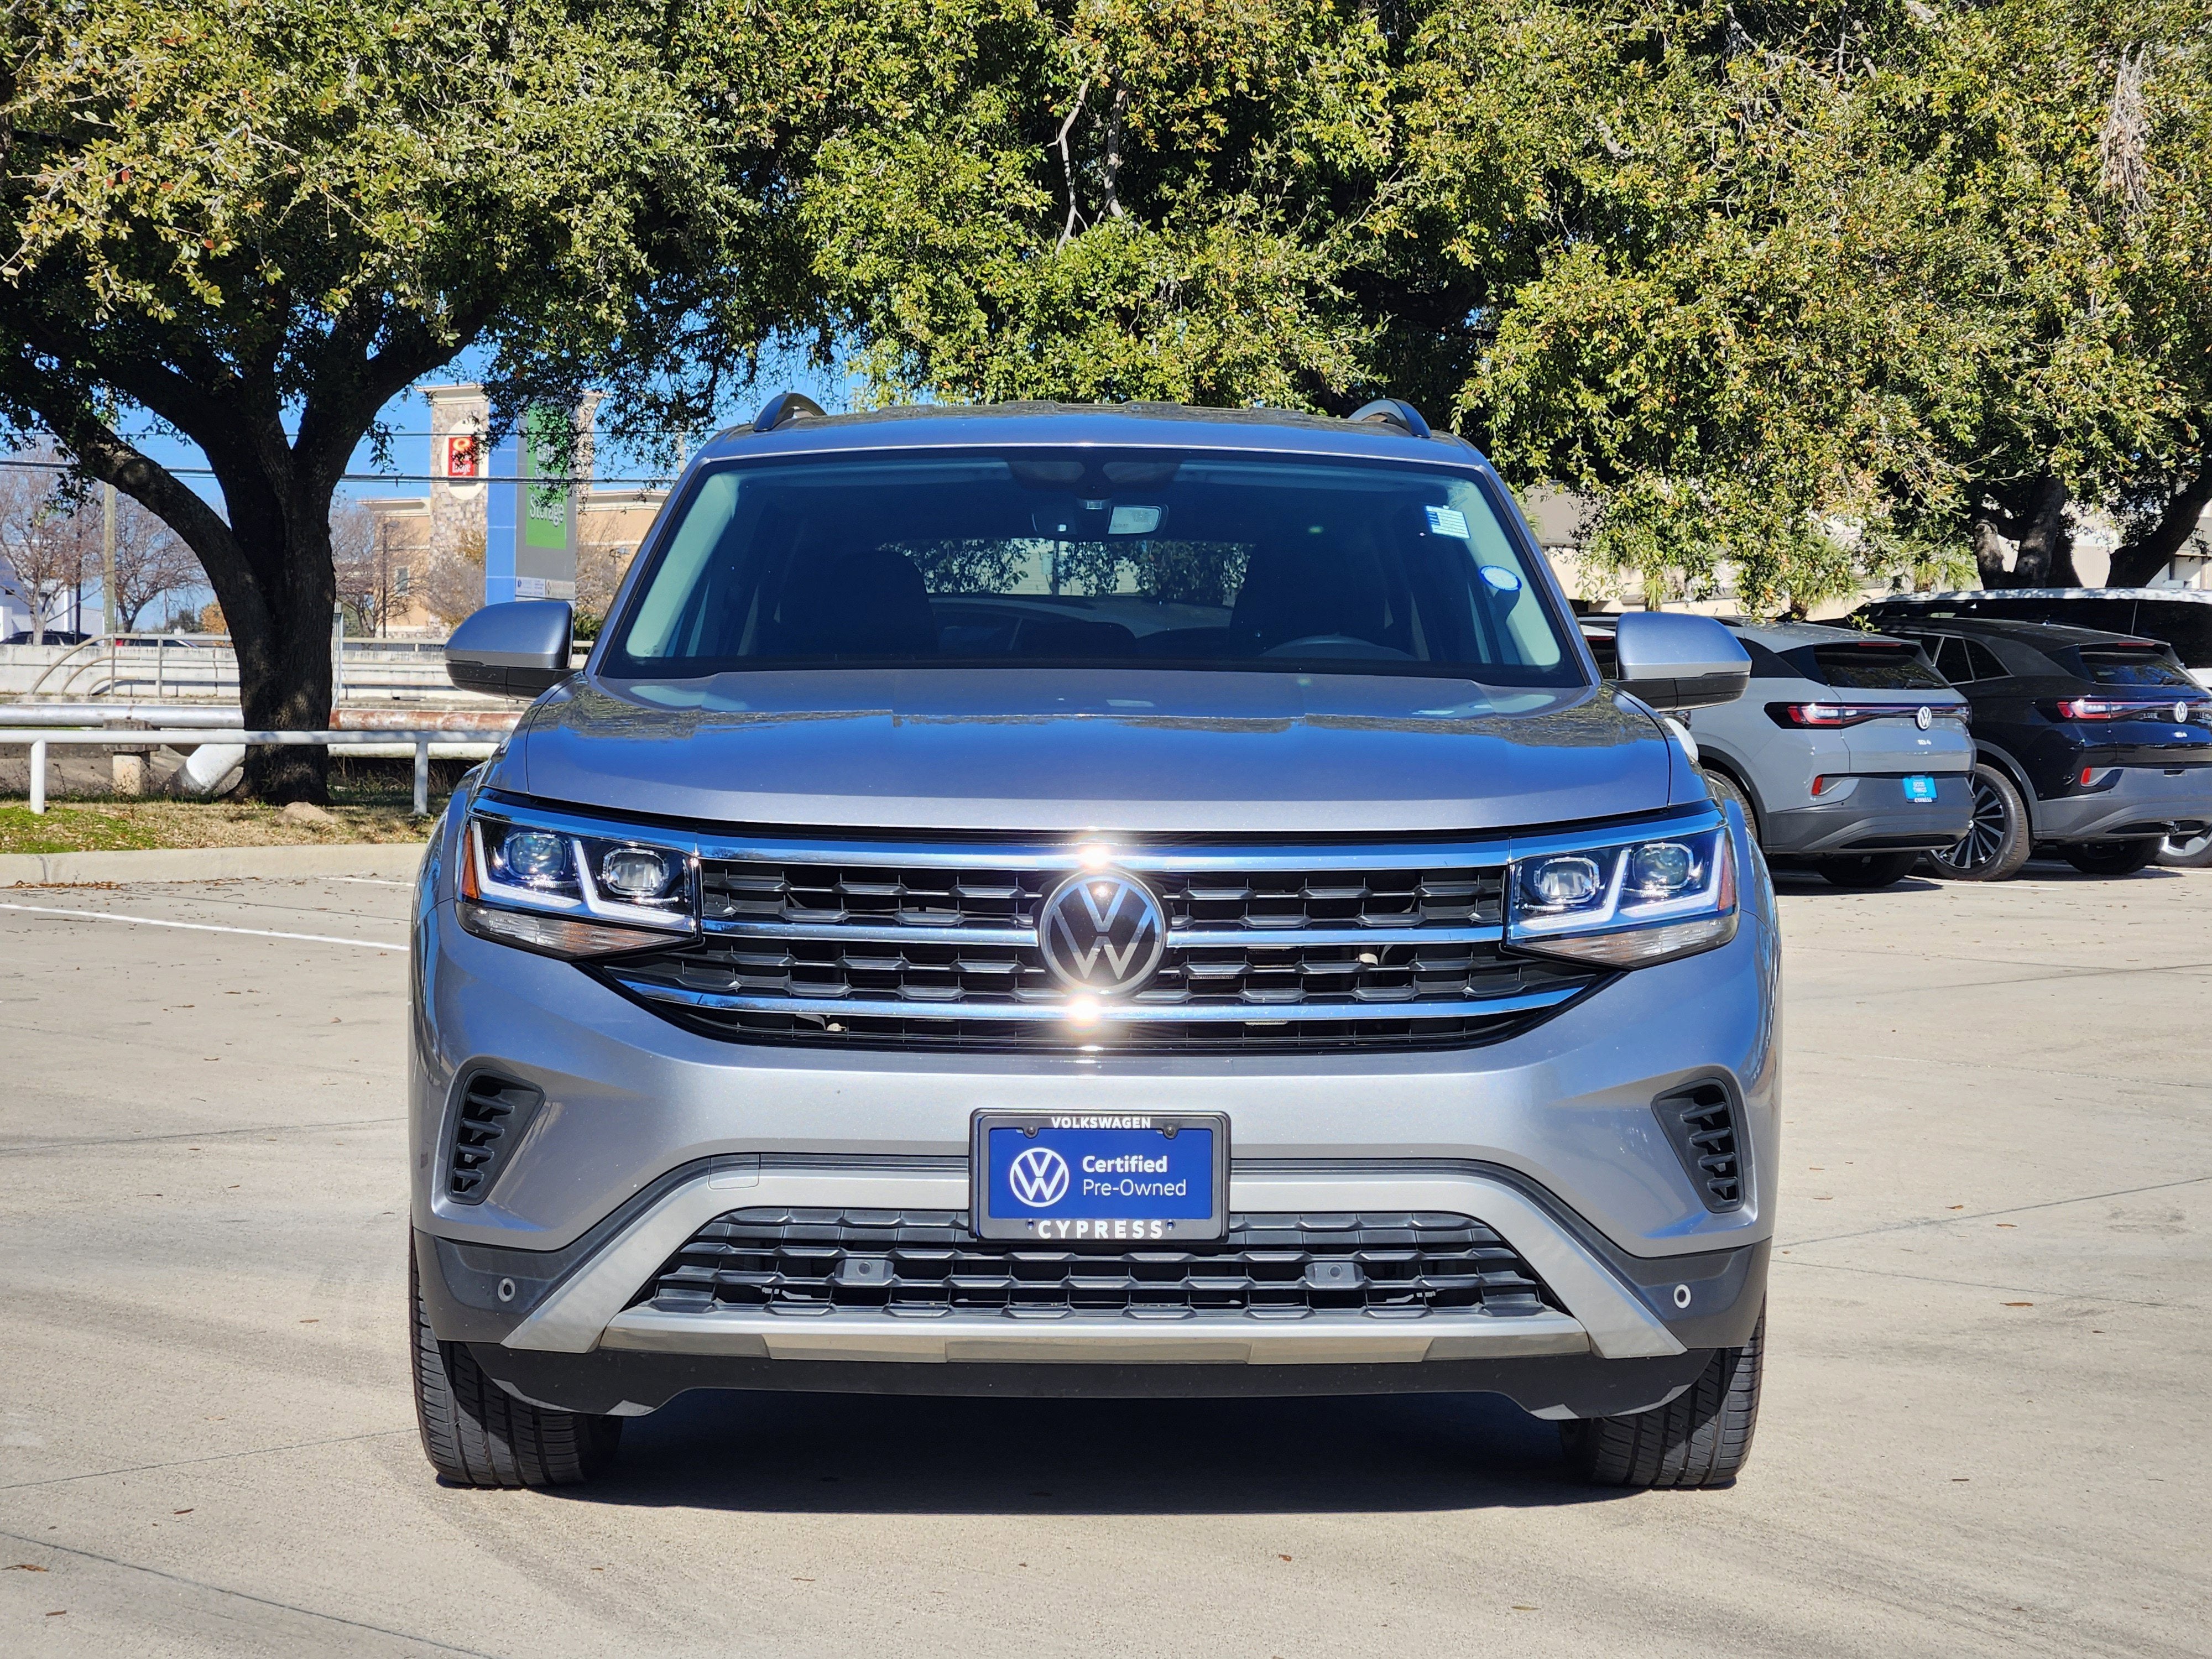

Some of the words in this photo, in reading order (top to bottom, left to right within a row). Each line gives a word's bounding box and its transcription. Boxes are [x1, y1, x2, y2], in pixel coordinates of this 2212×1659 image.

[1917, 706, 1932, 729] VW
[2176, 701, 2188, 723] VW
[1042, 874, 1164, 992] VW
[1051, 1117, 1151, 1129] VOLKSWAGEN
[1082, 1155, 1167, 1173] Certified
[1010, 1147, 1069, 1207] VW
[1083, 1179, 1186, 1196] Pre-Owned
[1038, 1220, 1163, 1239] CYPRESS
